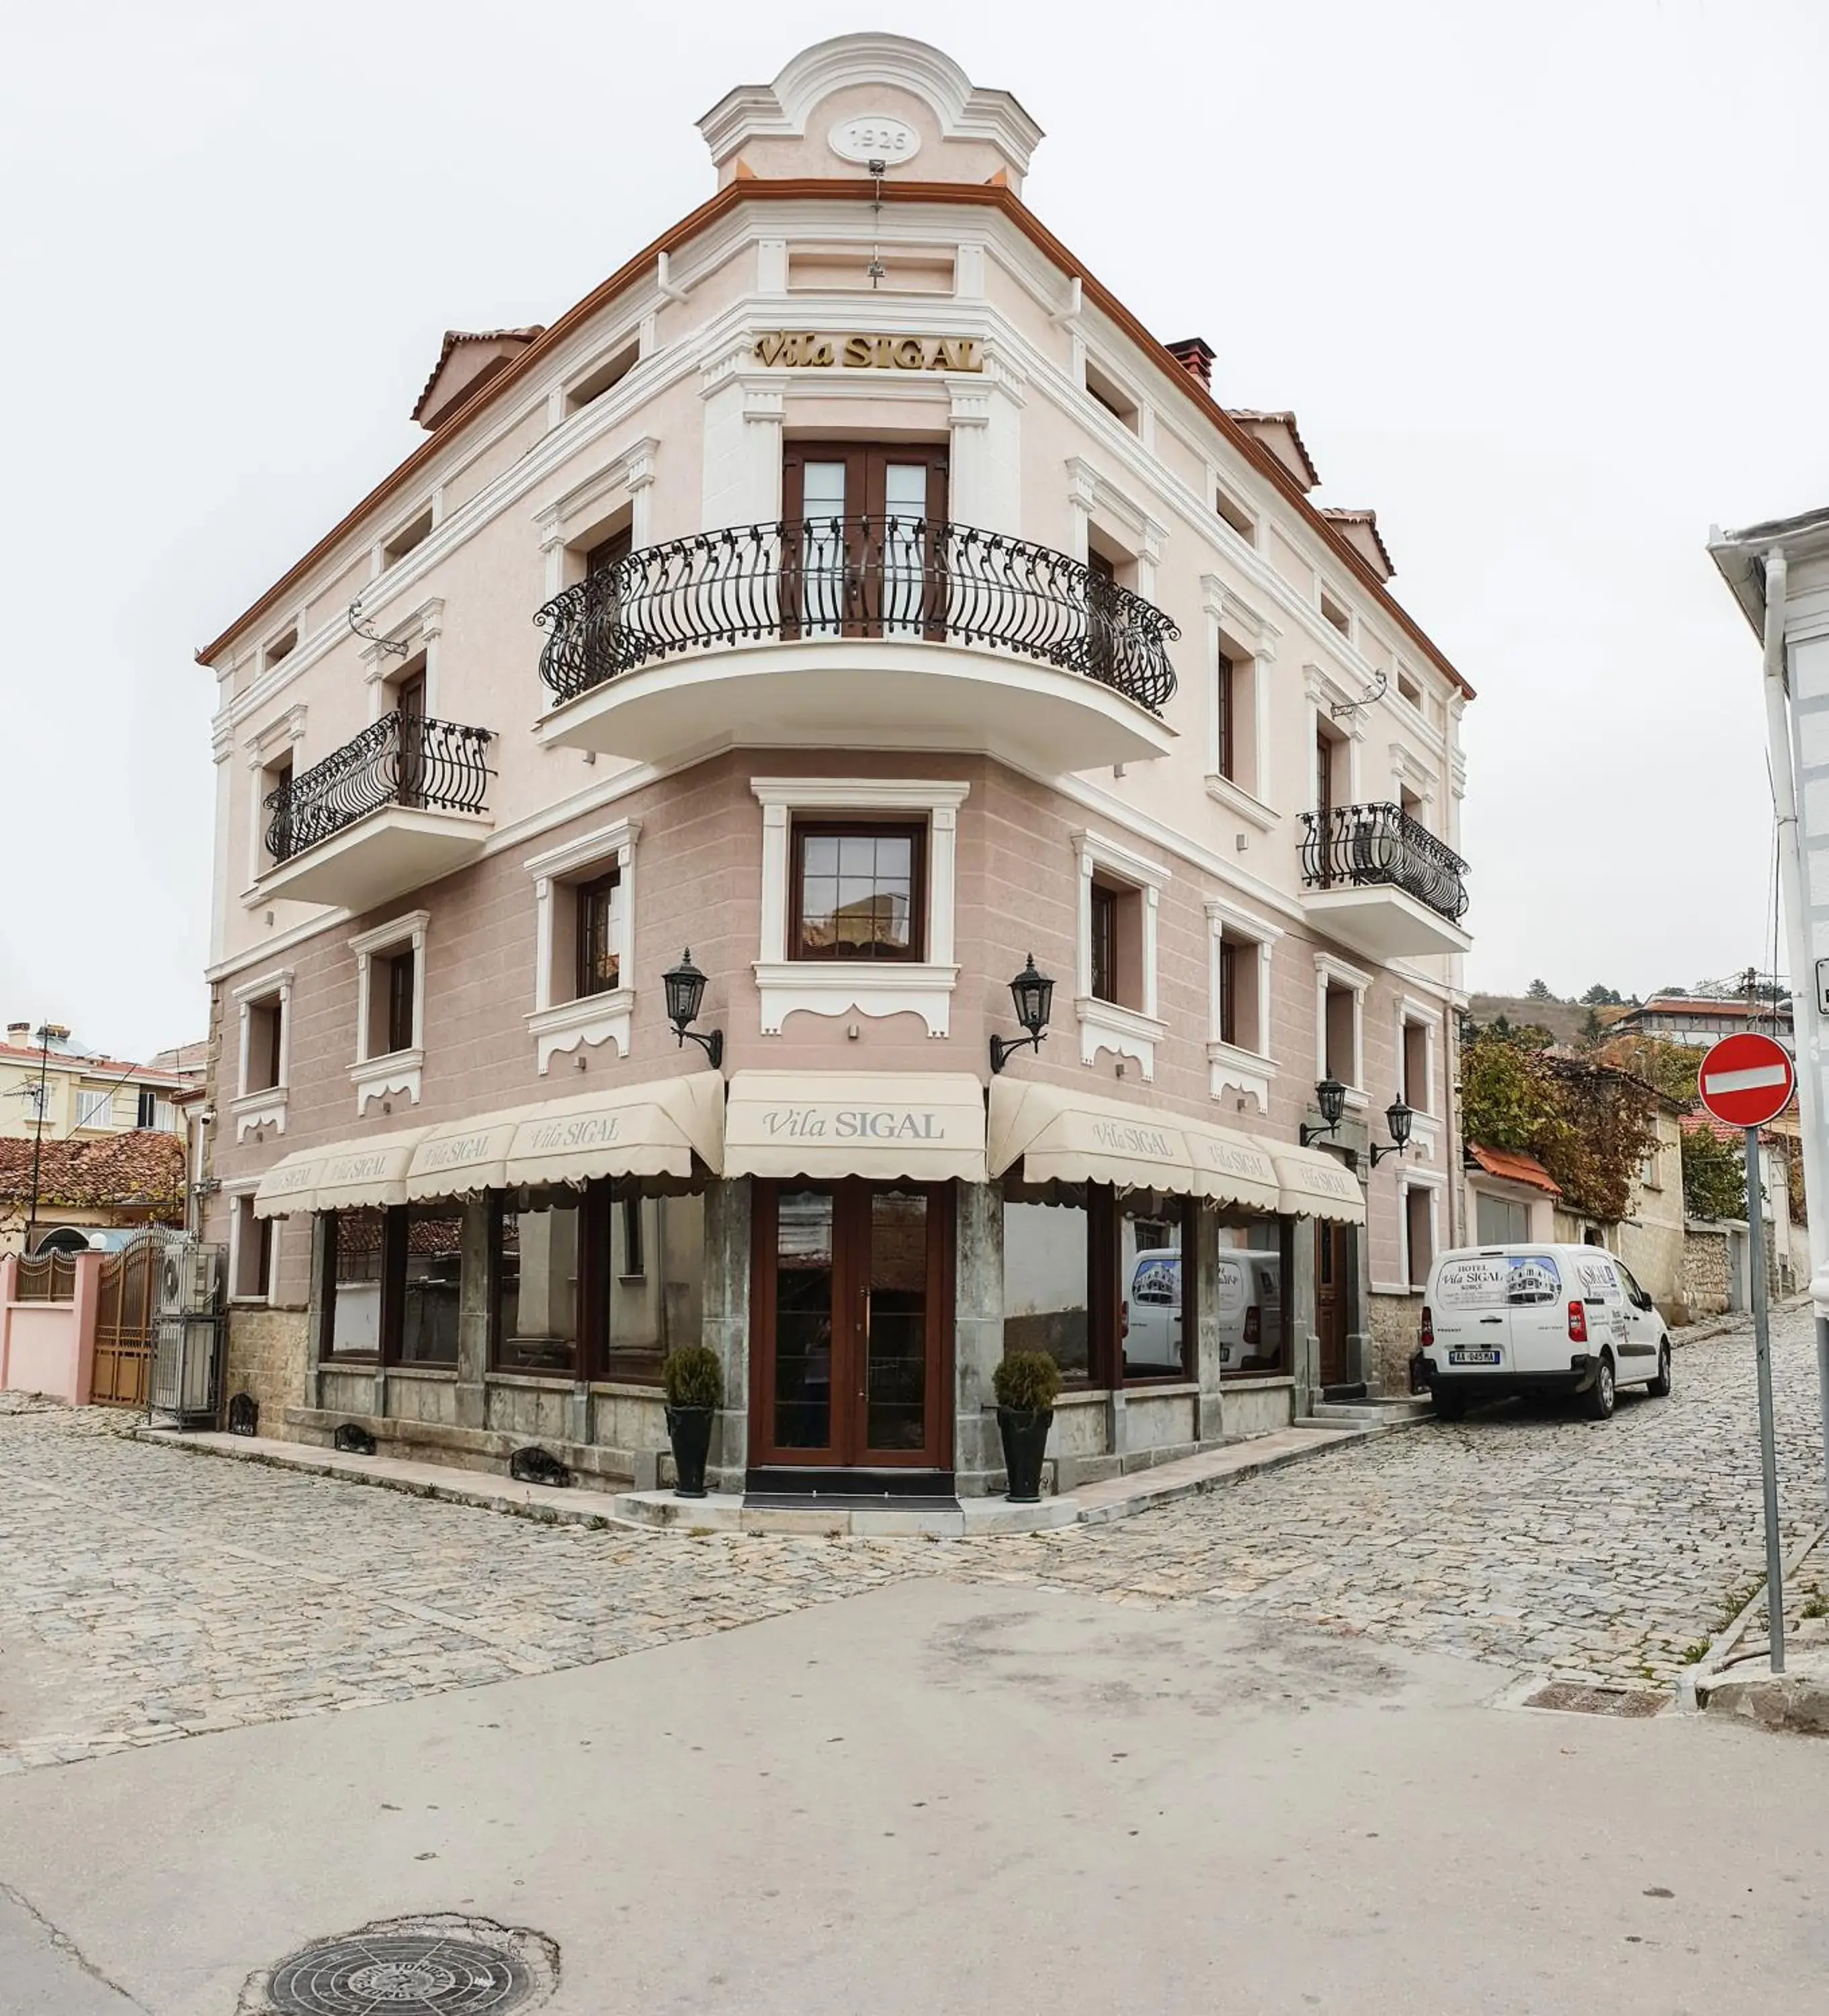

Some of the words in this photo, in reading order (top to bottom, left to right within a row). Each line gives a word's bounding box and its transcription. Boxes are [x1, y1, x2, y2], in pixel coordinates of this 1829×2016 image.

[753, 328, 835, 368] Vila
[842, 335, 984, 373] SIGAL
[563, 1118, 620, 1144] SIGAL
[763, 1109, 826, 1137] Vila
[835, 1111, 944, 1140] SIGAL
[1123, 1128, 1174, 1157] SIGAL
[1467, 1271, 1503, 1283] SIGAL
